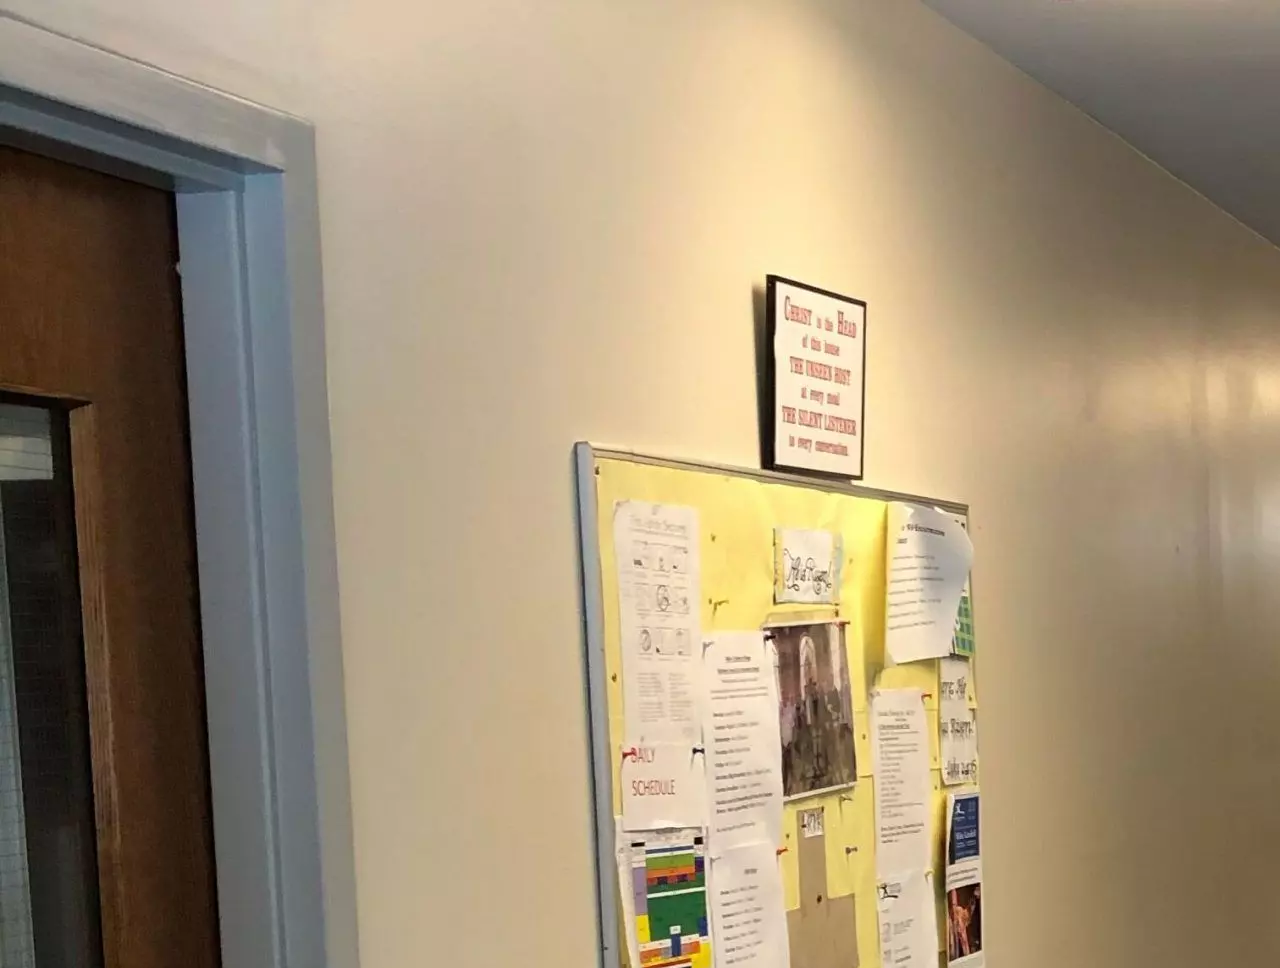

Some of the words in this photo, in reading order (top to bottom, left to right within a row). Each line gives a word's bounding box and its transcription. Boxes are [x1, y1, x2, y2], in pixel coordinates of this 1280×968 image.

[789, 355, 804, 375] THE
[781, 405, 797, 424] THE
[798, 408, 823, 430] SILENT
[824, 413, 857, 436] LISTENER
[632, 779, 676, 797] SCHEDULE
